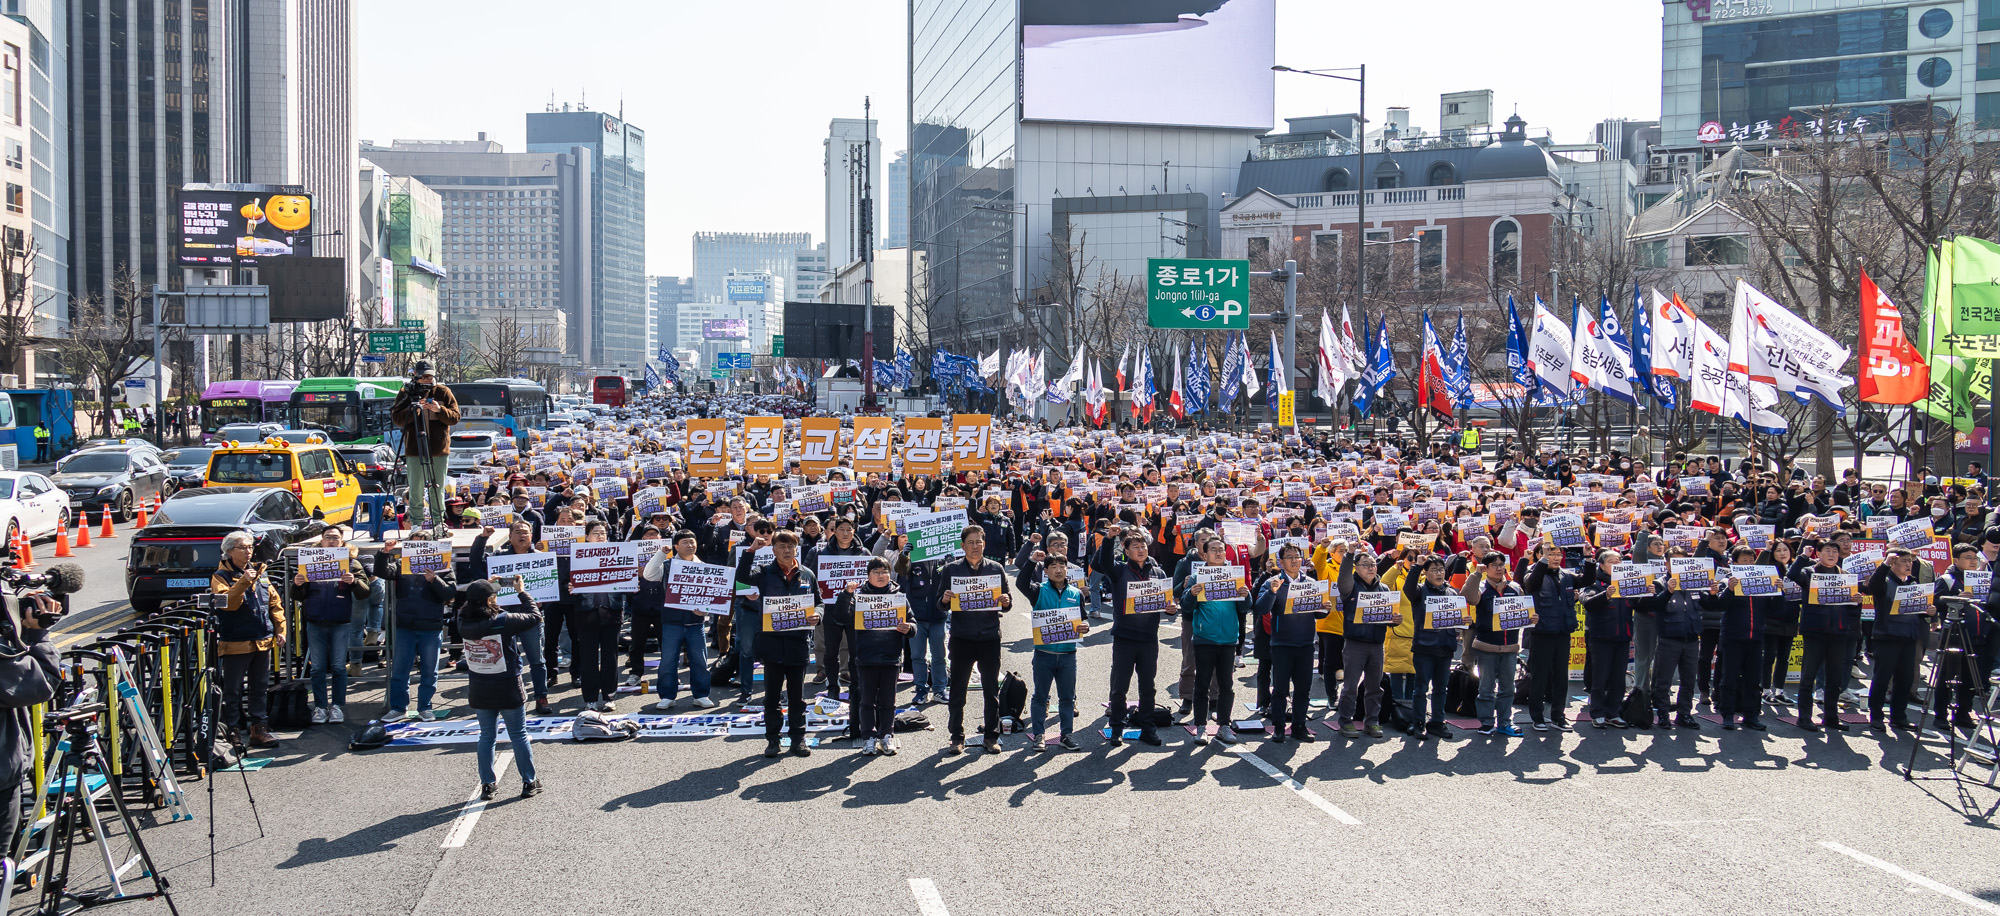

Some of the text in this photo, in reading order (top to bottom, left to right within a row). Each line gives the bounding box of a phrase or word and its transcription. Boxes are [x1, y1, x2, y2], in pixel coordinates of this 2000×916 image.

[1714, 5, 1773, 19] 722-8272
[198, 210, 218, 219] 누구나
[1156, 266, 1239, 287] 종로1가
[729, 285, 764, 294] 기프트인포
[1155, 289, 1220, 304] Jongno 1(il)-ga
[1202, 306, 1210, 320] 6
[1582, 345, 1624, 379] 충남세종
[689, 430, 726, 464] 원
[746, 427, 781, 462] 청
[801, 431, 839, 461] 교
[855, 428, 891, 461] 섭
[905, 429, 943, 462] 쟁
[953, 425, 989, 460] 취
[908, 513, 966, 529] 모든 건설노동자를 위한,
[1555, 519, 1576, 529] 나와라!
[920, 523, 958, 539] 건설현장의
[1550, 526, 1581, 539] 원청교섭
[1898, 524, 1919, 535] 나와라!
[916, 532, 962, 549] 미래를 만드는
[1895, 530, 1926, 545] 원청교섭
[416, 546, 438, 555] 나와라!
[574, 546, 620, 559] 중대재해가
[925, 543, 955, 557] 원청교섭
[1930, 551, 1948, 560] 80명
[312, 553, 335, 562] 나와라!
[410, 554, 442, 566] 원청교섭
[598, 556, 635, 568] 감소되는
[306, 560, 340, 572] 원청교섭
[491, 557, 555, 575] 고품질 주택 건설로
[681, 565, 725, 577] 건설노동자도
[1684, 564, 1704, 572] 나와라!
[673, 573, 729, 586] 빨간날 쉴 수 있는
[829, 569, 856, 578] 임금체불
[1210, 572, 1232, 581] 나와라!
[1623, 570, 1643, 579] 나와라!
[1679, 570, 1709, 581] 원청교섭
[187, 578, 206, 586] 5112
[965, 582, 989, 591] 나와라!
[1204, 579, 1236, 592] 원청교섭
[1618, 576, 1647, 589] 원청교섭
[1740, 576, 1772, 587] 원청교섭
[681, 586, 705, 596] 권리가
[705, 588, 728, 598] 보장된
[959, 588, 993, 601] 원청교섭
[1140, 586, 1162, 595] 나와라!
[1300, 587, 1320, 596] 나와라!
[1816, 586, 1850, 597] 원청교섭
[1906, 590, 1924, 599] 나와라!
[1134, 592, 1166, 605] 원청교섭
[1293, 594, 1323, 606] 원청교섭
[1369, 597, 1390, 606] 나와라!
[1899, 596, 1927, 607] 원청교섭
[778, 602, 801, 611] 나와라!
[869, 600, 893, 610] 나와라!
[1362, 605, 1393, 615] 원청교섭
[1438, 602, 1458, 610] 나와라!
[1504, 603, 1524, 611] 나와라!
[771, 609, 806, 622] 원청교섭
[863, 608, 898, 620] 원청교섭
[1045, 614, 1068, 624] 나와라!
[1432, 609, 1462, 620] 원청교섭
[1498, 609, 1530, 621] 원청교섭
[1039, 621, 1073, 635] 원청교섭
